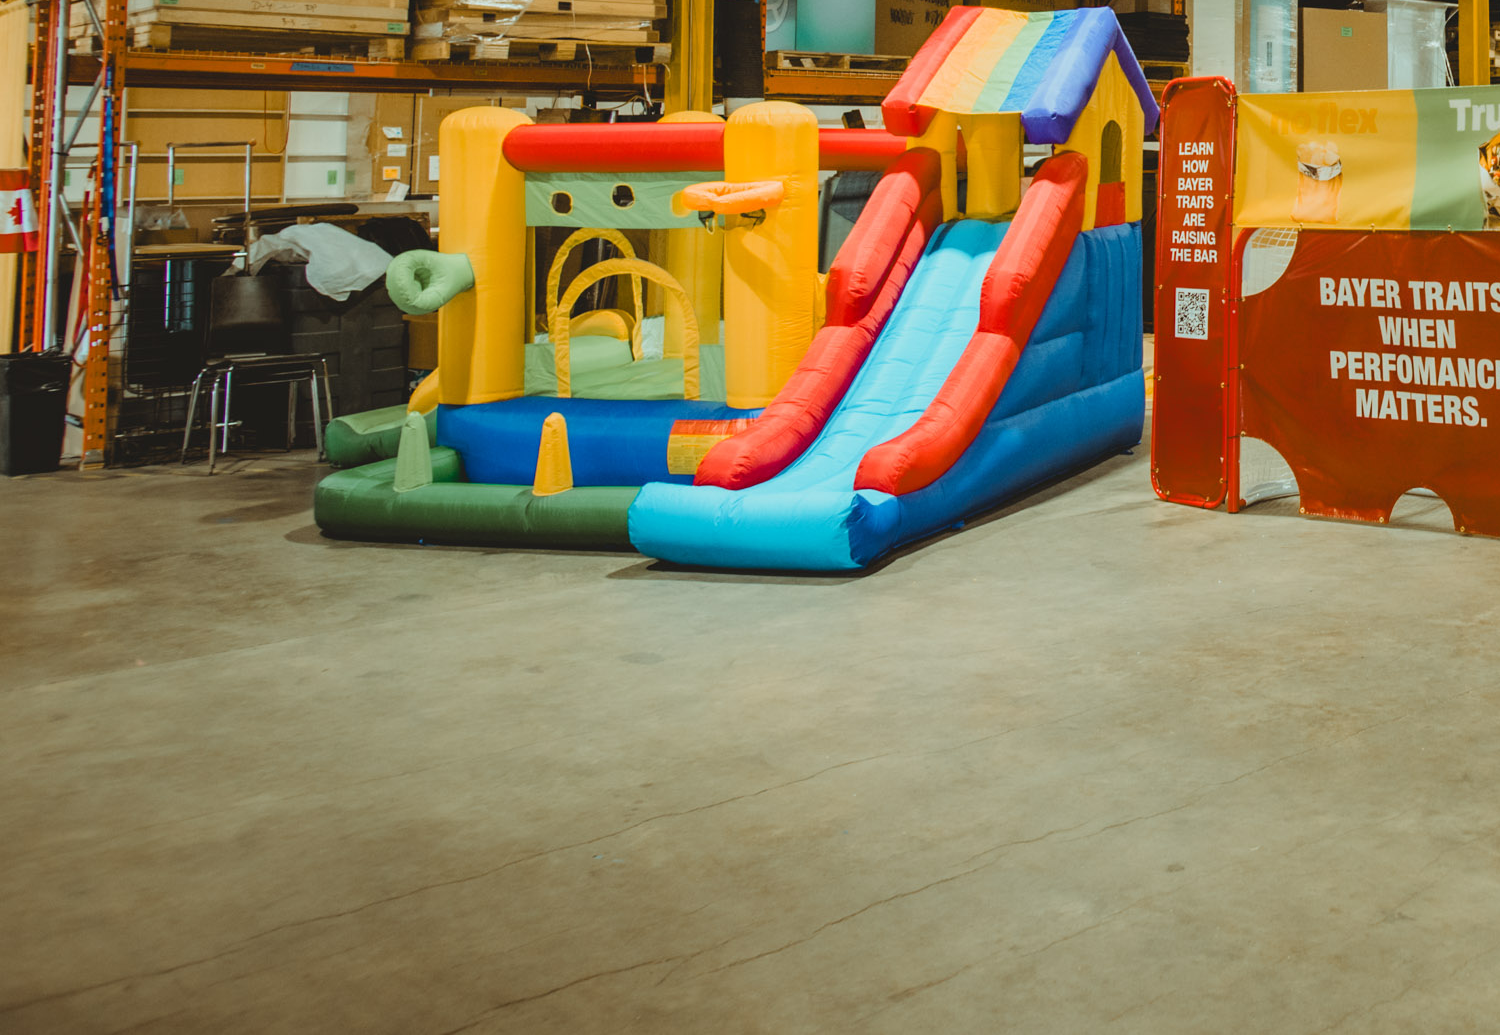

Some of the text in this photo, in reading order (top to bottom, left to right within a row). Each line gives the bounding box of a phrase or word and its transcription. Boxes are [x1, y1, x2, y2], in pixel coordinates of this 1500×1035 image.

[1271, 102, 1379, 135] no flex
[1178, 142, 1214, 155] LEARN
[1182, 159, 1209, 173] HOW
[1177, 177, 1213, 191] BAYER
[1176, 195, 1214, 209] TRAITS
[1182, 213, 1206, 226] ARE
[1172, 230, 1216, 245] RAISING
[1170, 248, 1218, 263] THE BAR
[1319, 277, 1402, 309] BAYER
[1378, 315, 1457, 349] WHEN
[1355, 388, 1488, 428] MATTERS.
